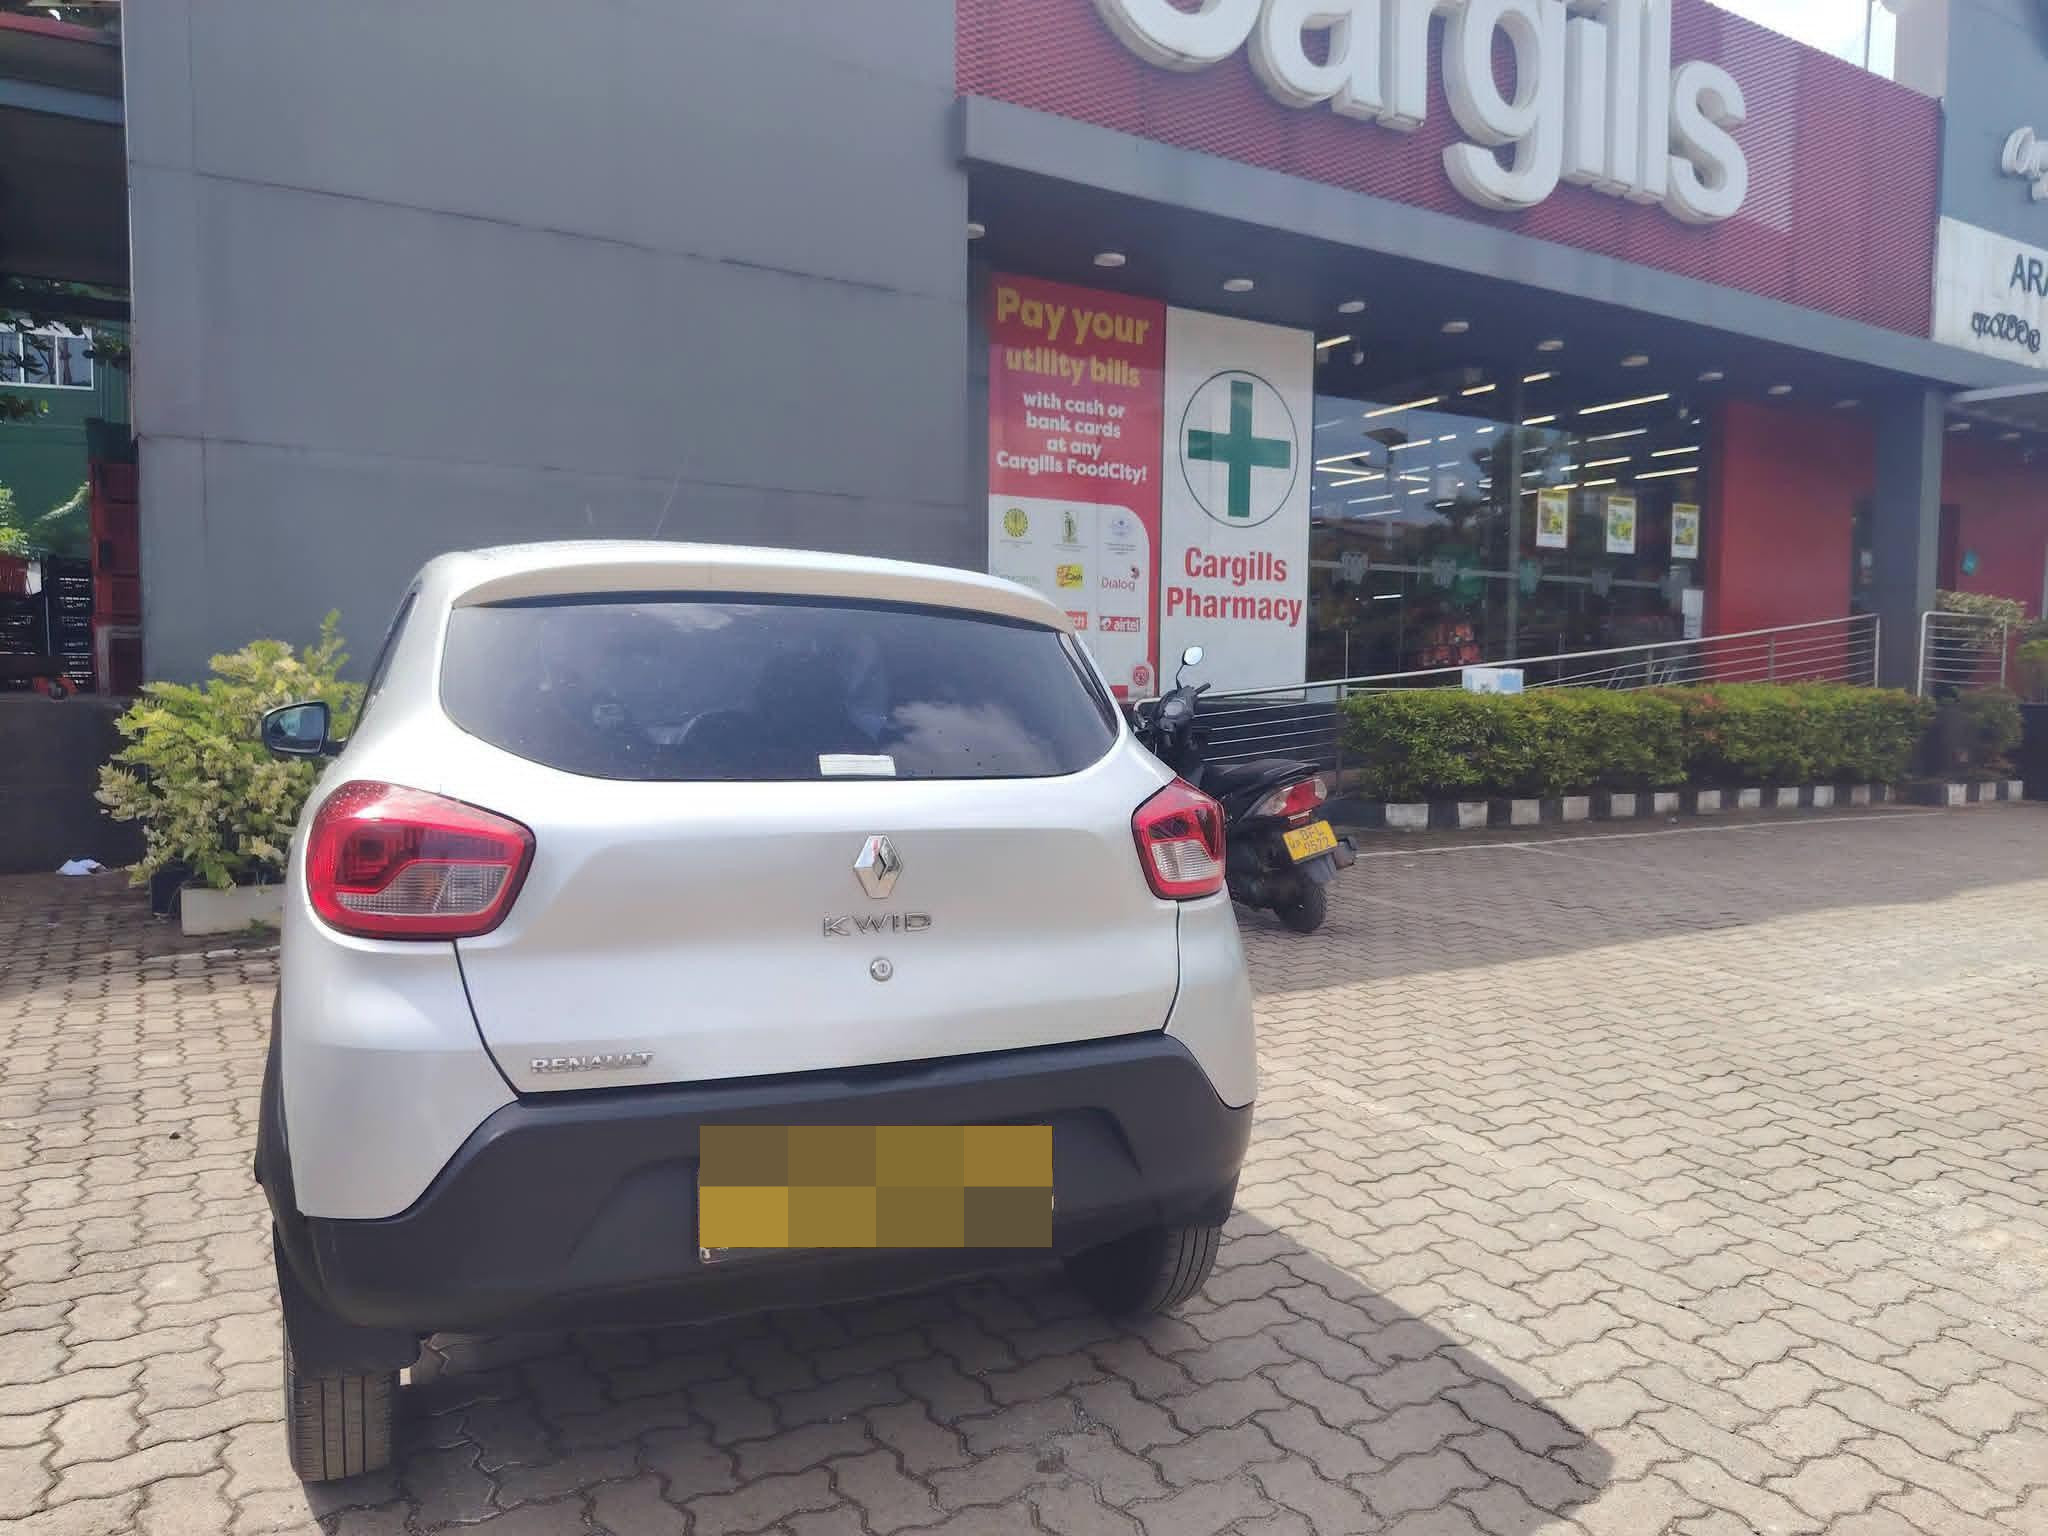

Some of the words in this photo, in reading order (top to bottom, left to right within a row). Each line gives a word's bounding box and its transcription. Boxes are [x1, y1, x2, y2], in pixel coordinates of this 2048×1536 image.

[2010, 254, 2048, 297] AR
[997, 288, 1064, 341] Pay
[1072, 308, 1149, 344] your
[1005, 347, 1084, 386] utility
[1090, 356, 1141, 387] bills
[1023, 392, 1061, 411] with
[1065, 398, 1104, 417] cash
[1108, 403, 1126, 418] or
[1026, 412, 1070, 433] bank
[1075, 418, 1121, 439] cards
[1047, 437, 1066, 451] at
[1071, 440, 1102, 460] any
[996, 451, 1063, 475] Cargills
[1068, 459, 1148, 485] FoodCity!
[1185, 547, 1287, 586] Cargills
[1101, 575, 1136, 592] Dialog
[1166, 587, 1303, 628] Pharmacy
[1113, 617, 1140, 632] airtel
[823, 912, 932, 938] KWID
[530, 1052, 655, 1073] RENAULT
